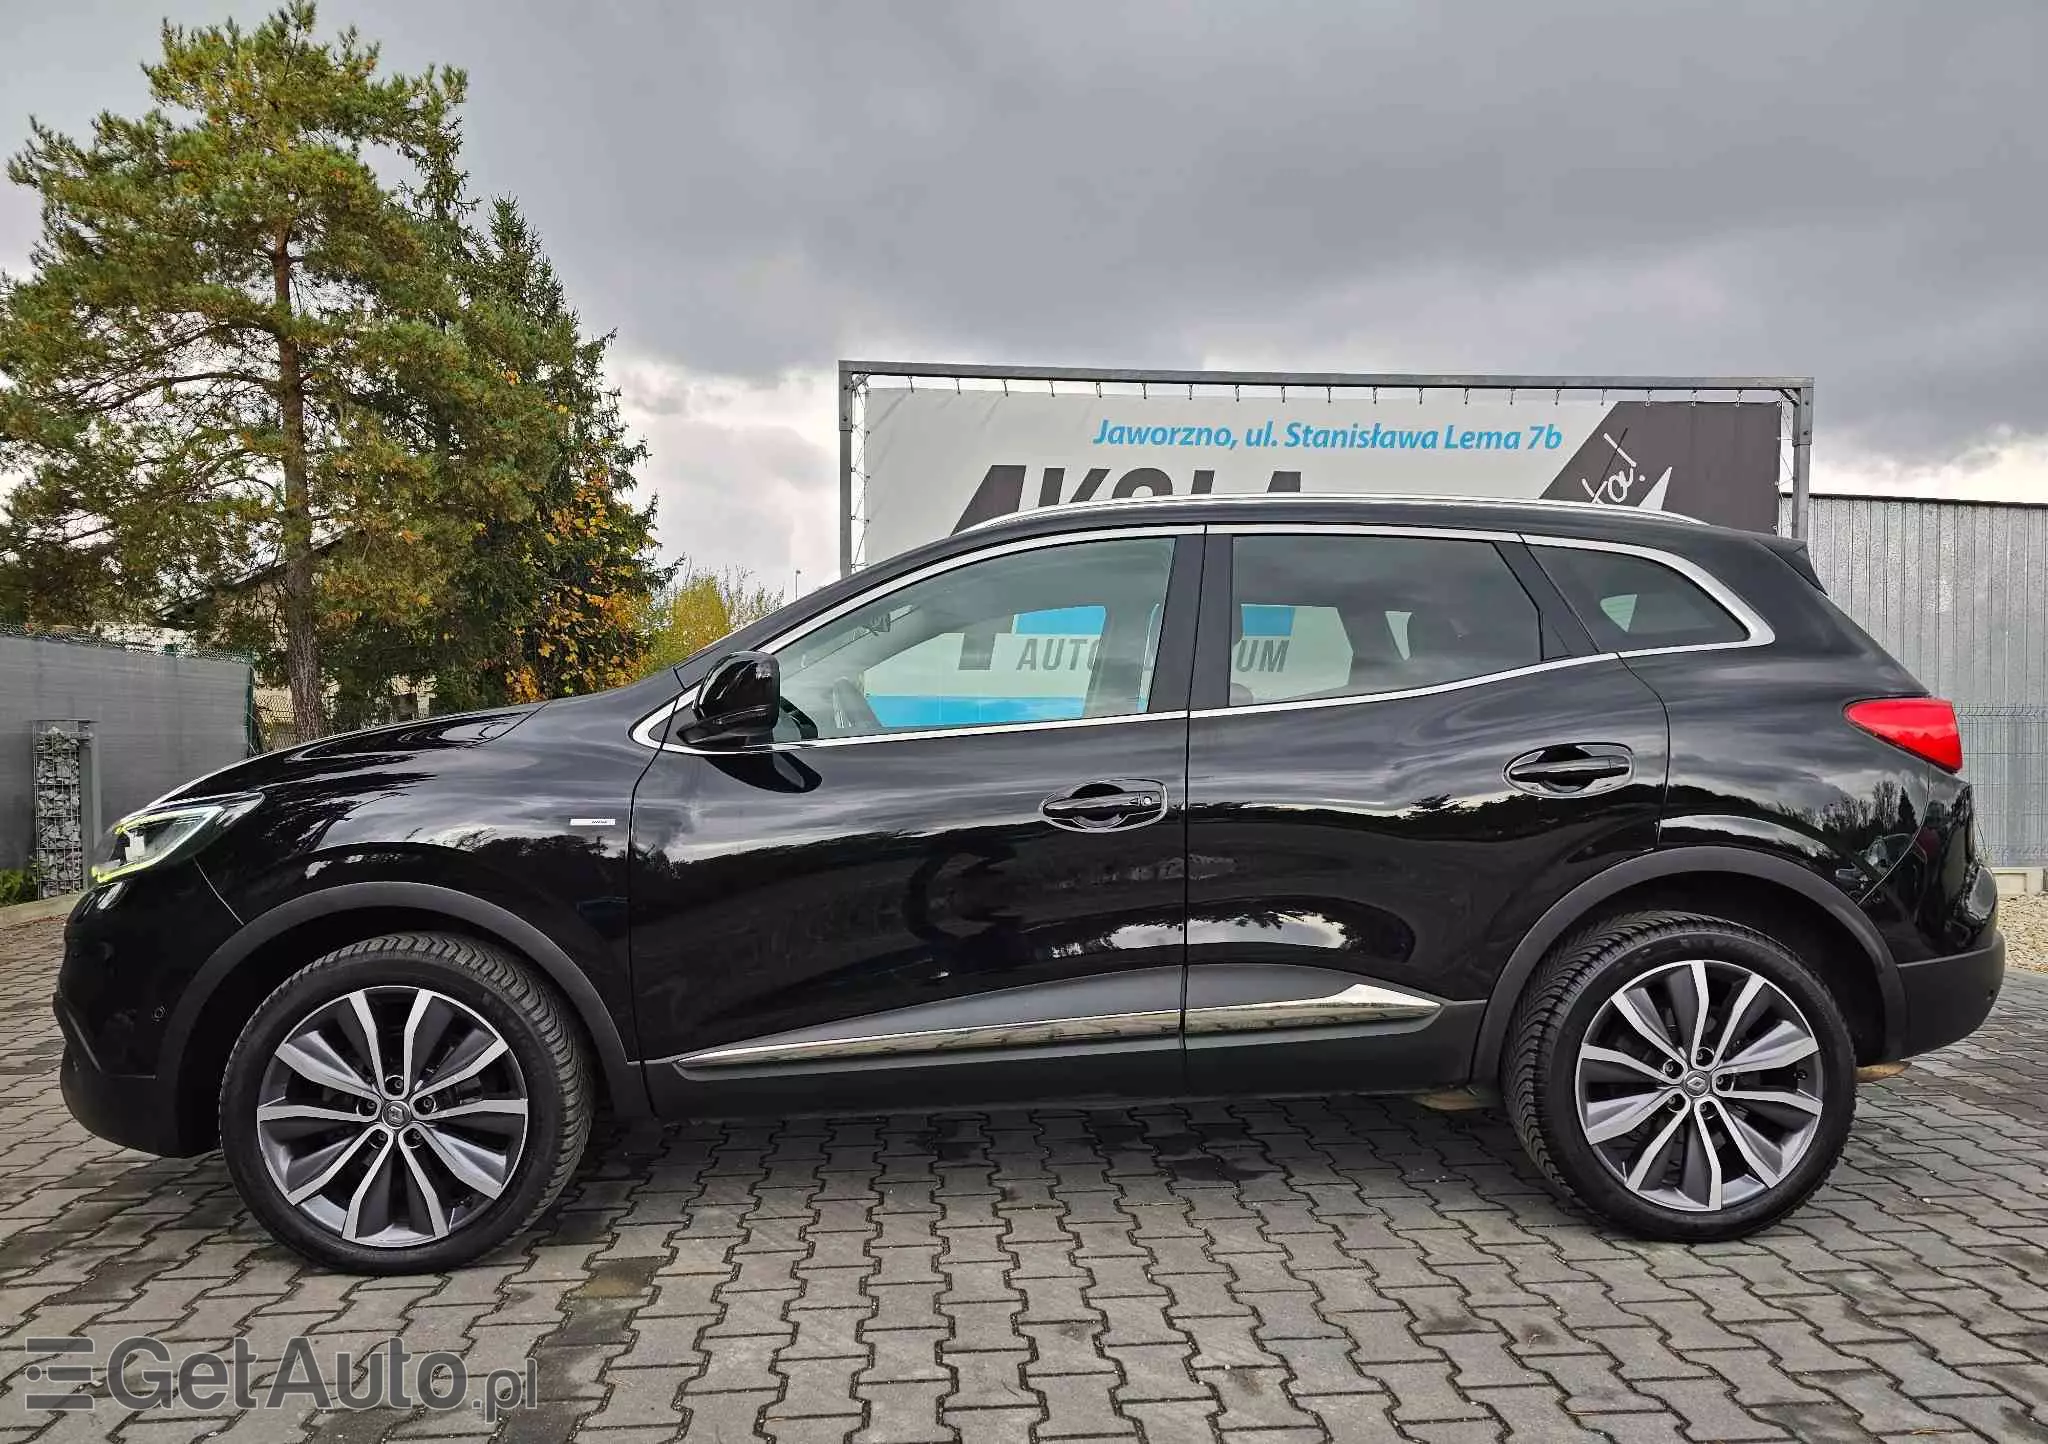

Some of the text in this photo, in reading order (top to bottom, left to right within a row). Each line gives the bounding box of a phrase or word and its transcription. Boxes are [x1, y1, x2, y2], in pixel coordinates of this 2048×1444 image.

[1093, 419, 1562, 450] Jaworzno, ul. Stanisława Lema 7b
